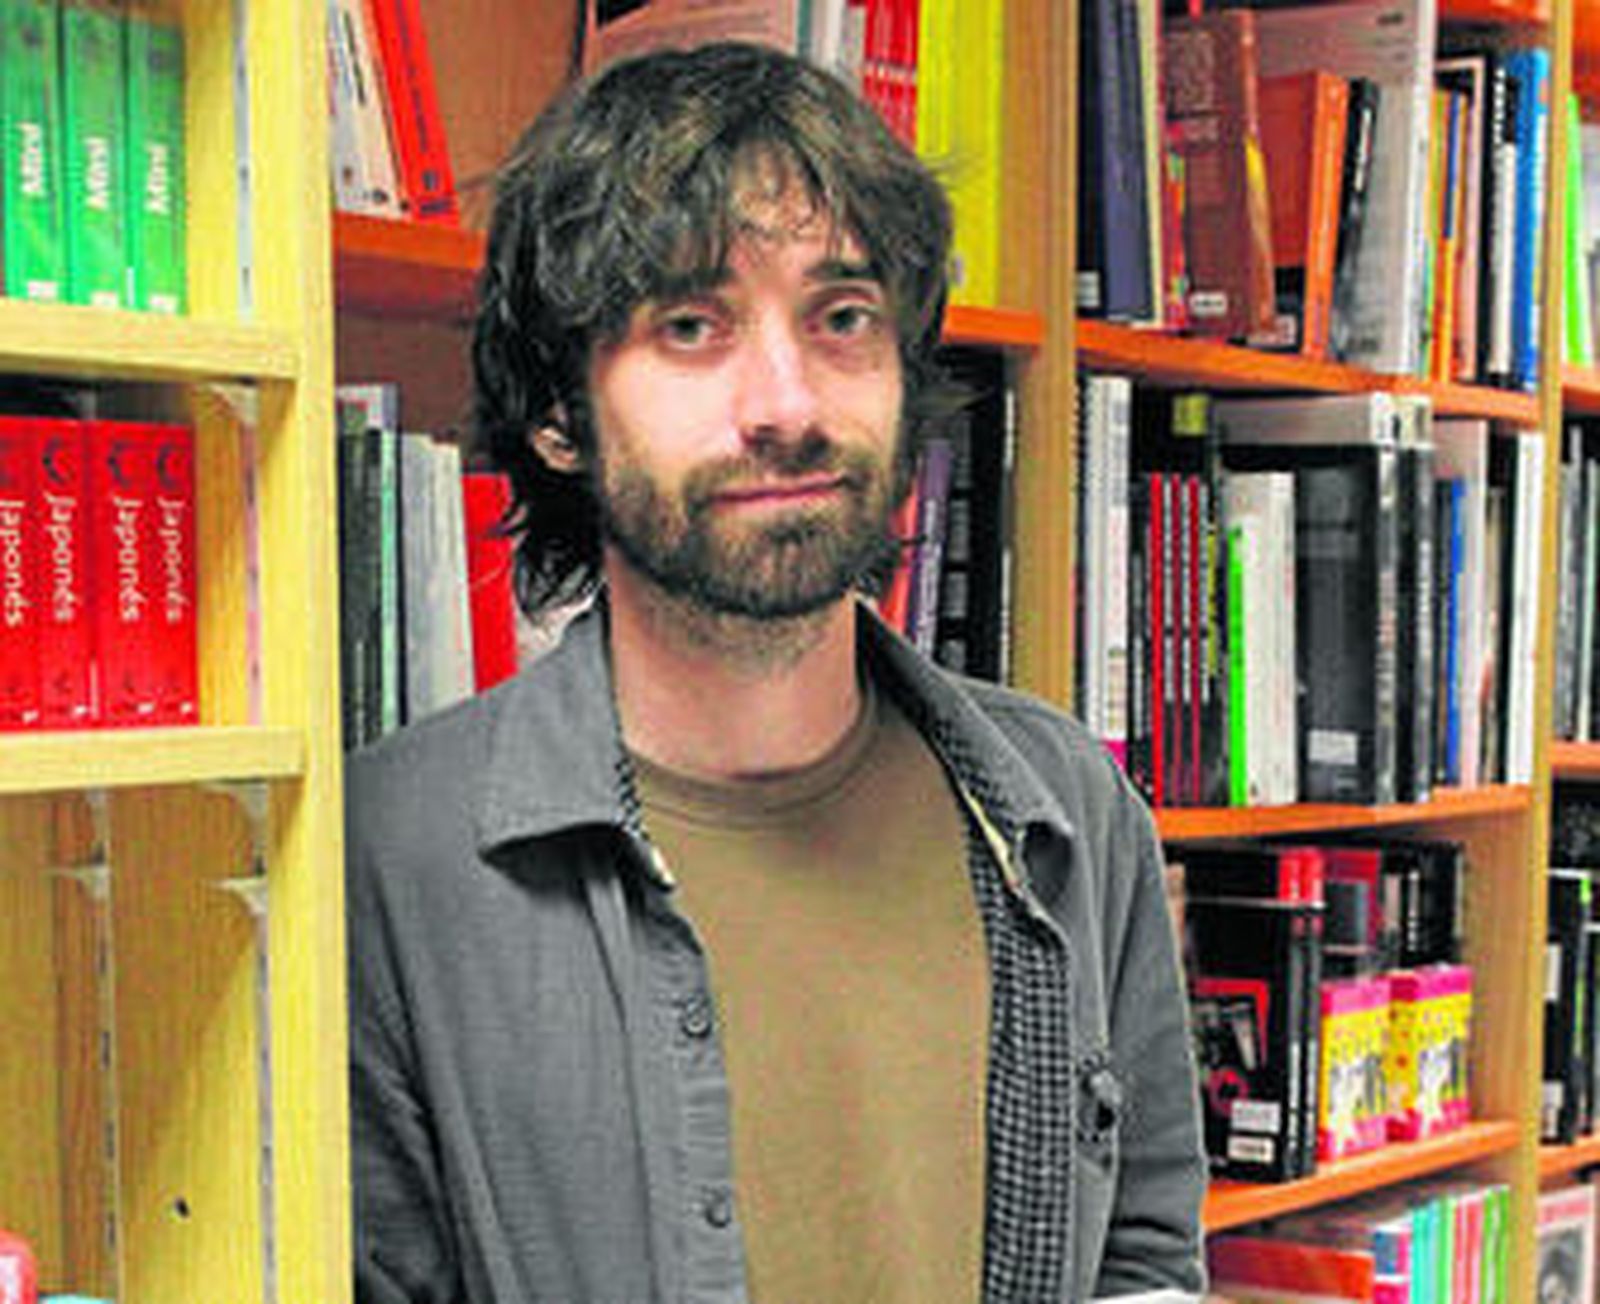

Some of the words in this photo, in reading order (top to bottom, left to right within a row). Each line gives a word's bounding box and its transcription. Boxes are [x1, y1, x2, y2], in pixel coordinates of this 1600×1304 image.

[43, 491, 81, 622] Japonés
[110, 494, 147, 622] Japonés
[156, 496, 190, 623] Japonés
